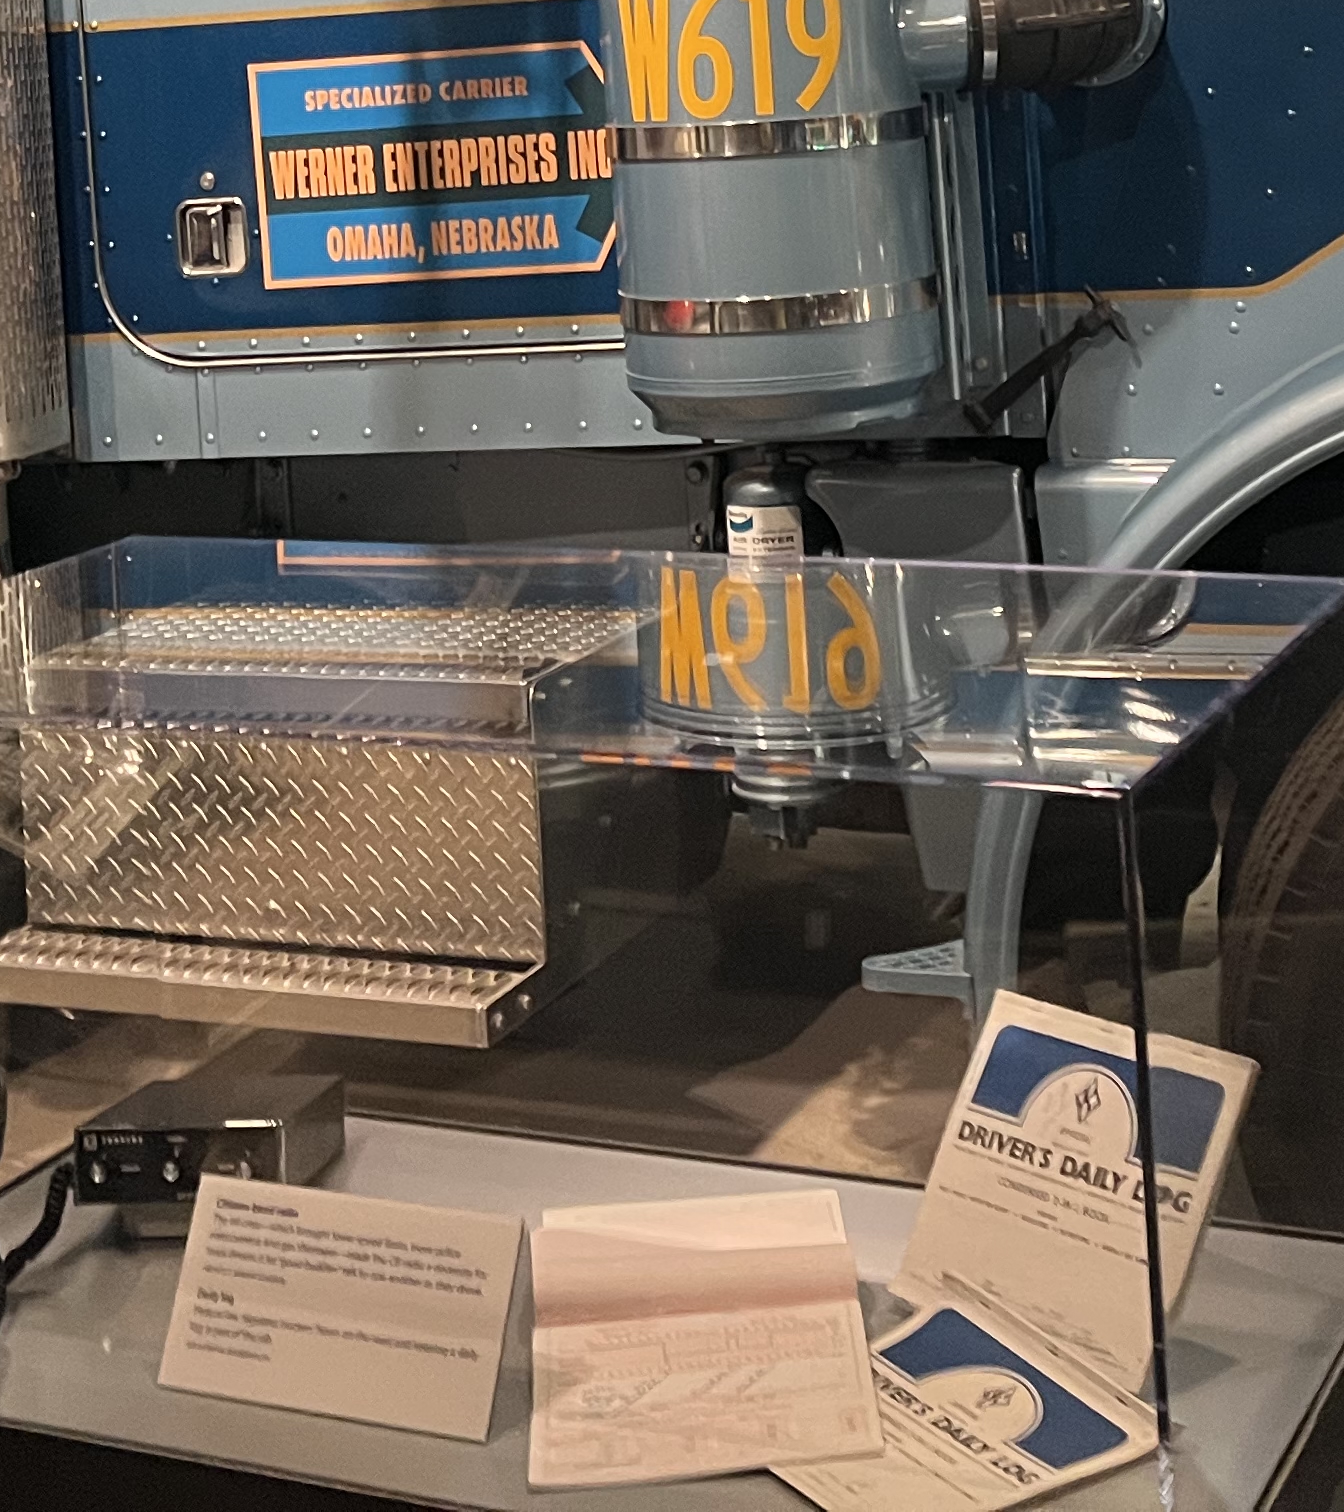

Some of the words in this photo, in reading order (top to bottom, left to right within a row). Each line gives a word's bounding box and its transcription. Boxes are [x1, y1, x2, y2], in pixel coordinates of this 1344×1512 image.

[304, 82, 431, 112] SPECIALIZED
[438, 75, 529, 101] CARRIER
[269, 144, 376, 200] WERNER
[382, 132, 558, 193] ENTERPRISES
[327, 223, 426, 264] OMAHA,
[431, 214, 559, 256] NEBRASKA
[958, 1120, 1053, 1168] DRIVER'S
[1059, 1155, 1128, 1194] DAILY
